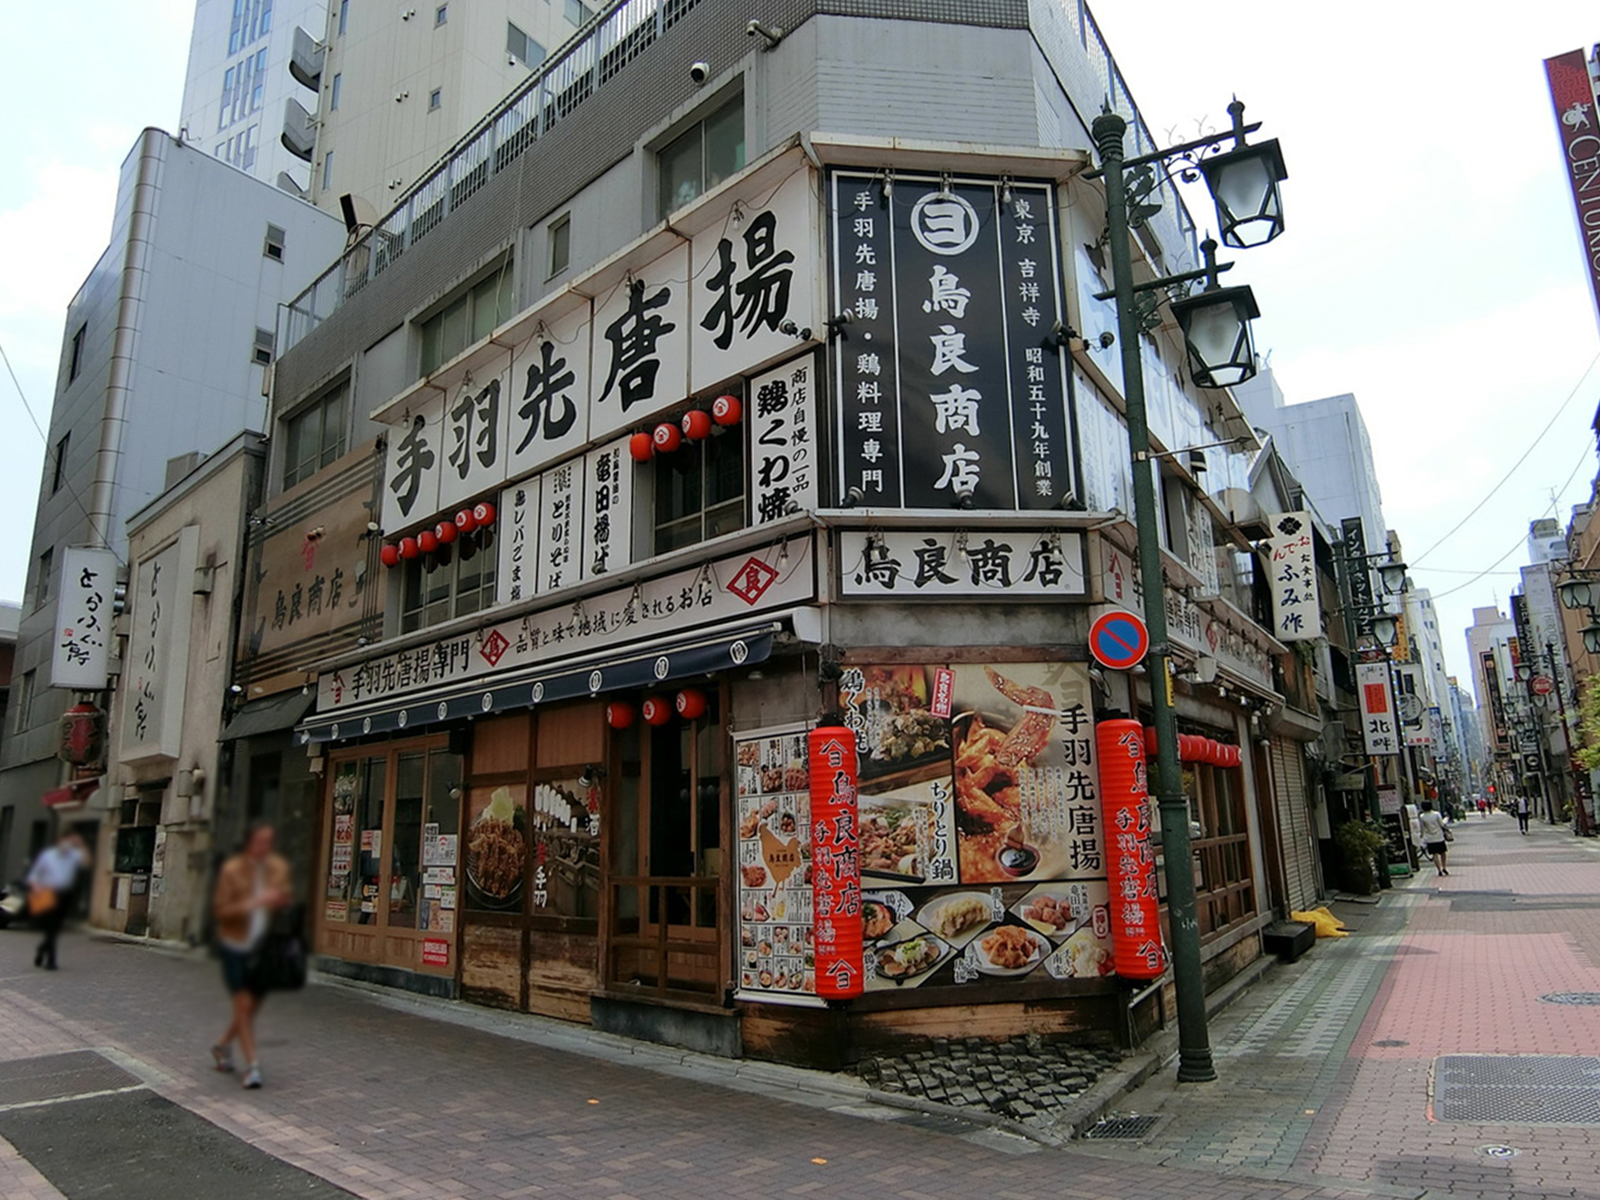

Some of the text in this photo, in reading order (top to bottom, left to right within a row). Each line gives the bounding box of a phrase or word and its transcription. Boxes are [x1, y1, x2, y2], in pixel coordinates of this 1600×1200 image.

[390, 210, 796, 518] 手羽先唐揚
[853, 191, 884, 493] 手羽先唐揚・鶏料理専門
[921, 264, 983, 494] 鳥良商店
[1013, 199, 1053, 497] 東京 吉祥寺 昭和五十九年創業
[757, 380, 793, 524] 鶏くわ焼
[790, 366, 810, 493] 商店自慢の一品
[271, 567, 344, 630] 鳥良商店
[549, 500, 565, 590] とりそば
[855, 536, 1065, 590] 鳥良商店
[1273, 536, 1310, 562] おでん
[1278, 564, 1304, 634] ふみ作
[1301, 553, 1315, 602] お食事処
[62, 567, 103, 665] とらふぐ亭
[134, 561, 160, 741] とらふぐ亭
[352, 639, 471, 700] 手羽先唐揚専門
[515, 580, 714, 655] 品質と味で地域に愛されるお店
[829, 770, 861, 916] 鳥良商店
[930, 782, 954, 880] ちりとり鍋
[1060, 703, 1101, 871] 手羽先唐揚
[814, 819, 836, 944] 手羽先唐揚
[1115, 807, 1145, 926] 手羽先唐揚
